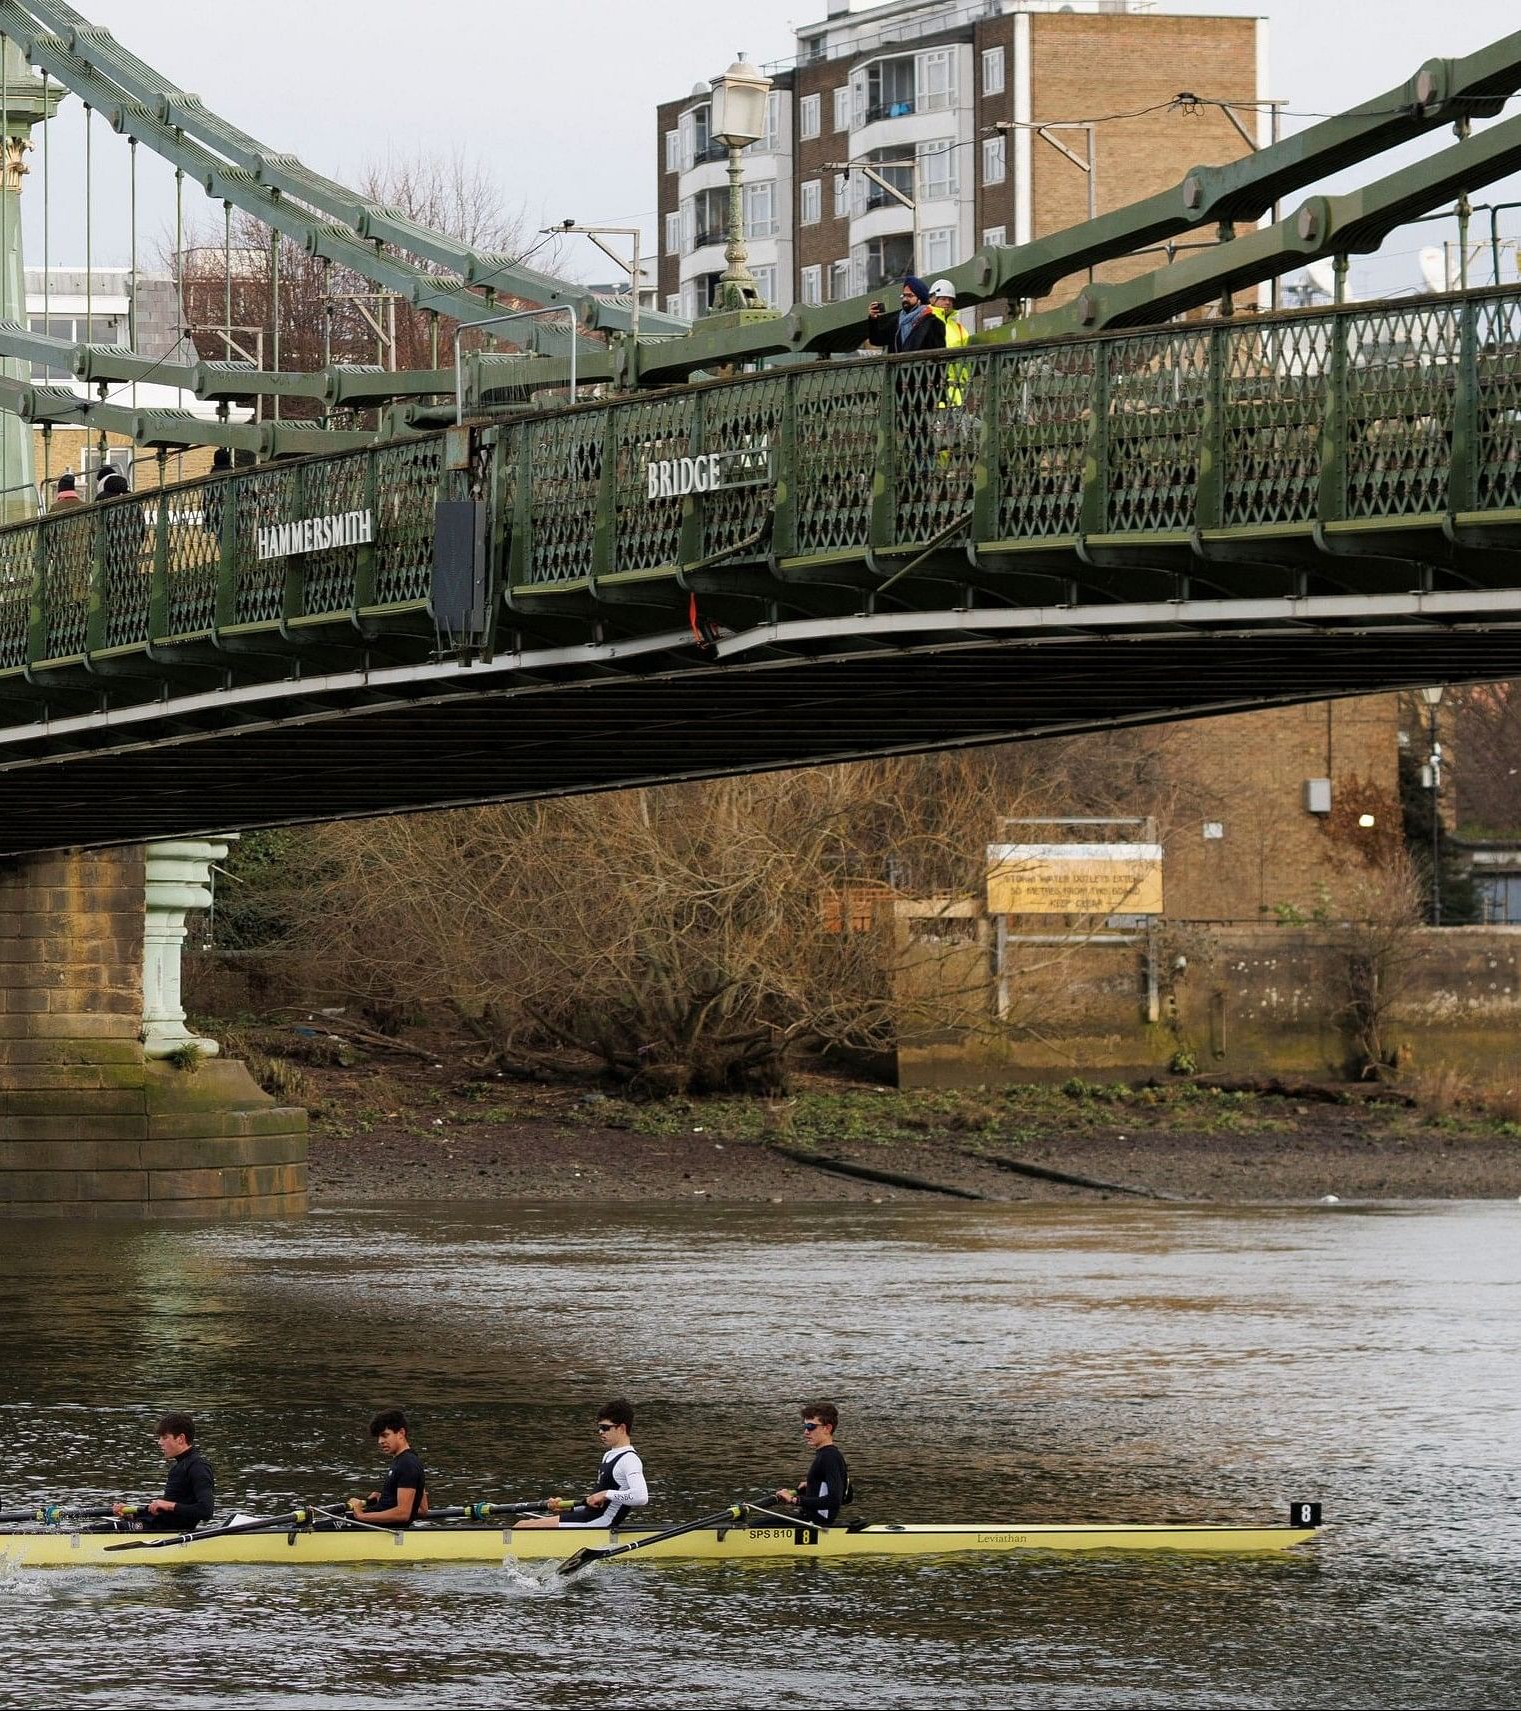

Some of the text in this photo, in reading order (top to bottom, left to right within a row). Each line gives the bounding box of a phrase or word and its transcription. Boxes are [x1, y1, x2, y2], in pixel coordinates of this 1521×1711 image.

[648, 453, 720, 499] BRIDGE
[257, 508, 372, 560] HAMMERSMITH
[1073, 875, 1110, 883] OUTLETS
[1301, 1504, 1311, 1523] 8
[749, 1529, 793, 1539] SPS 810
[802, 1529, 810, 1544] 8
[977, 1534, 1027, 1543] Leviathan
